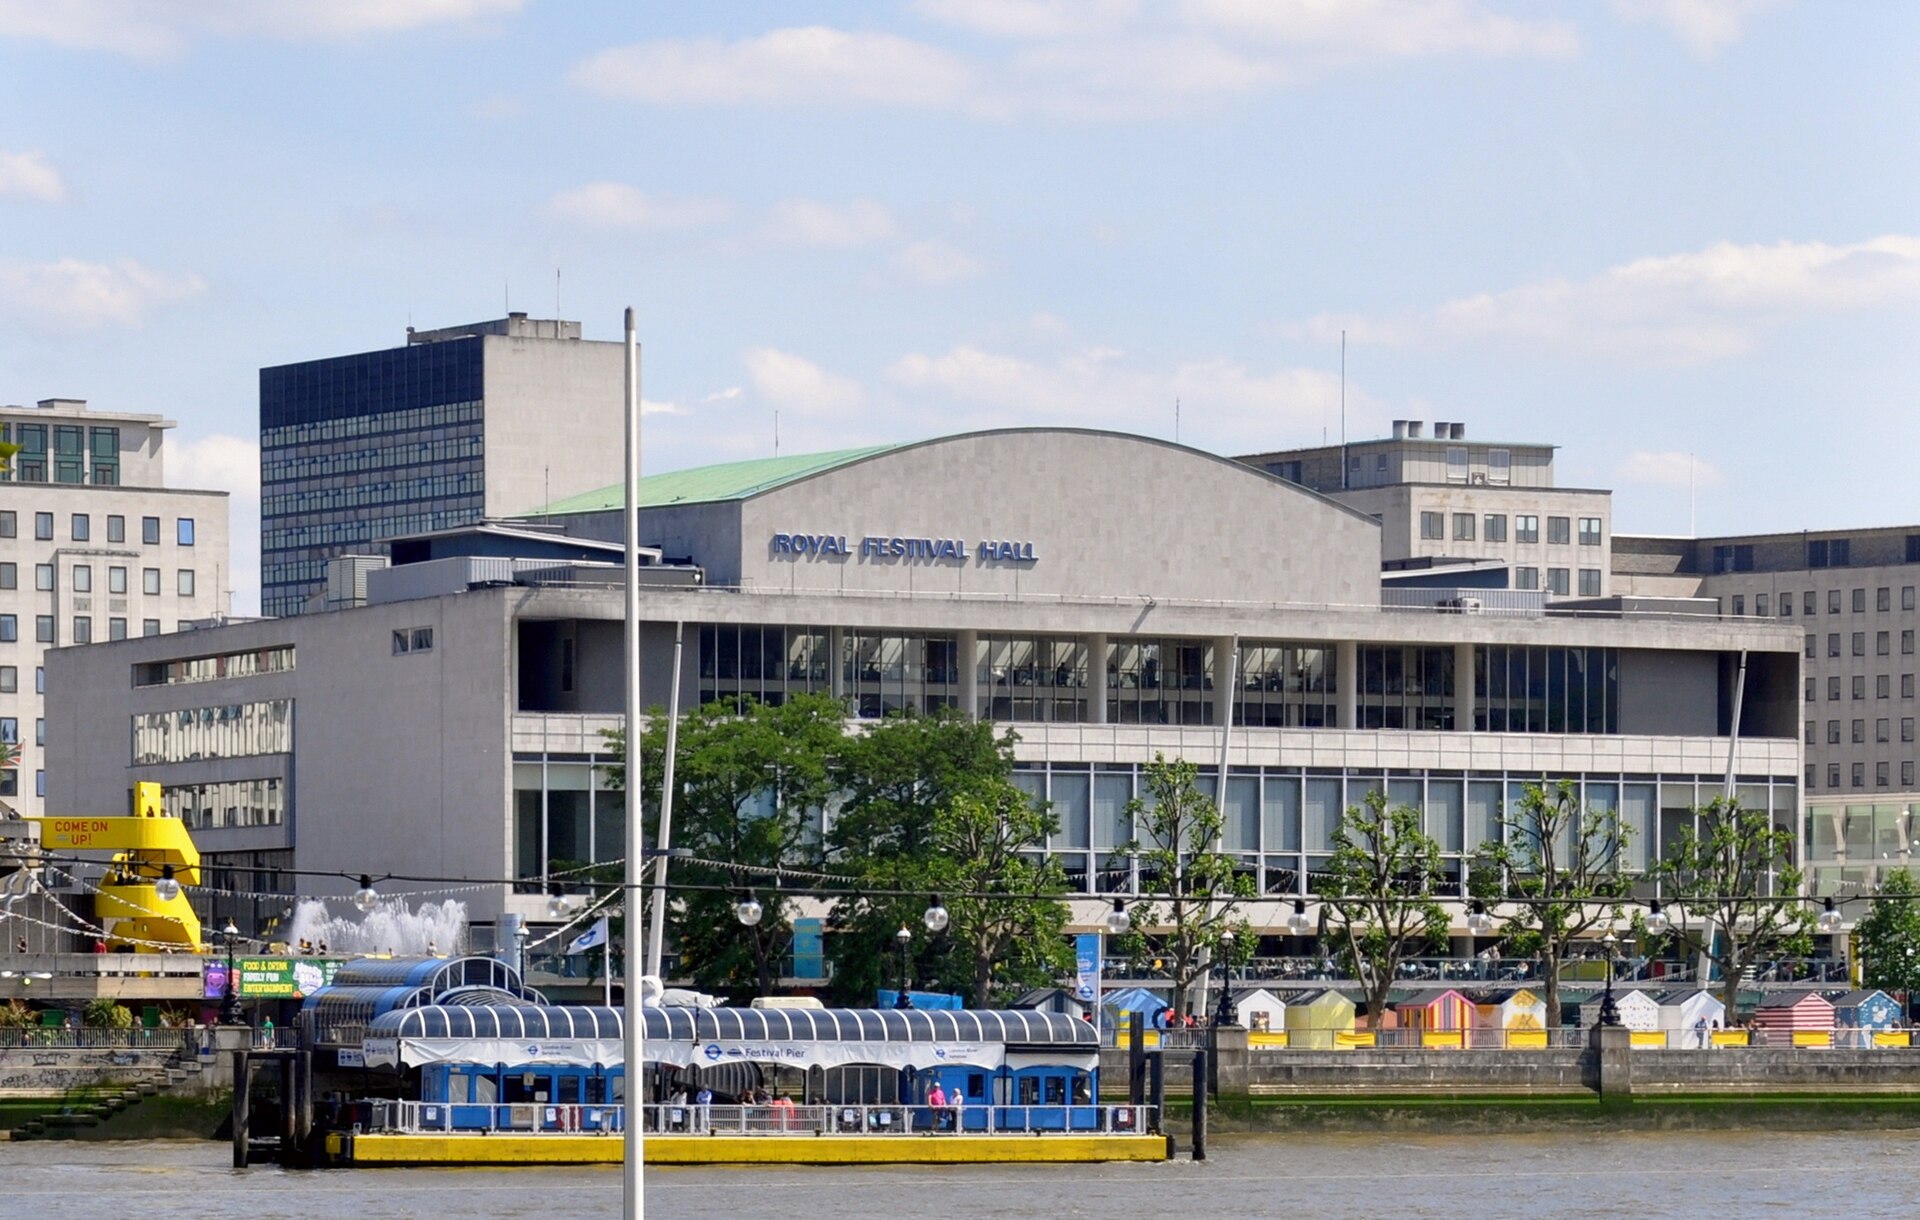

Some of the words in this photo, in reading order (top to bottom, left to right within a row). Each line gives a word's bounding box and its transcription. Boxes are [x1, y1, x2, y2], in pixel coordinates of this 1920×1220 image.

[773, 533, 851, 555] ROYAL
[863, 535, 970, 559] FESTIVAL
[980, 539, 1038, 561] HALL
[55, 822, 89, 832] COME
[92, 822, 108, 832] ON
[71, 834, 92, 845] UP!
[243, 961, 260, 971] FOOD
[267, 961, 288, 971] DRINK
[243, 972, 265, 982] FAMILY
[266, 972, 279, 982] FUN
[243, 983, 293, 993] ENTERTAINMENT
[745, 1048, 783, 1058] Festival
[786, 1048, 805, 1058] Pier
